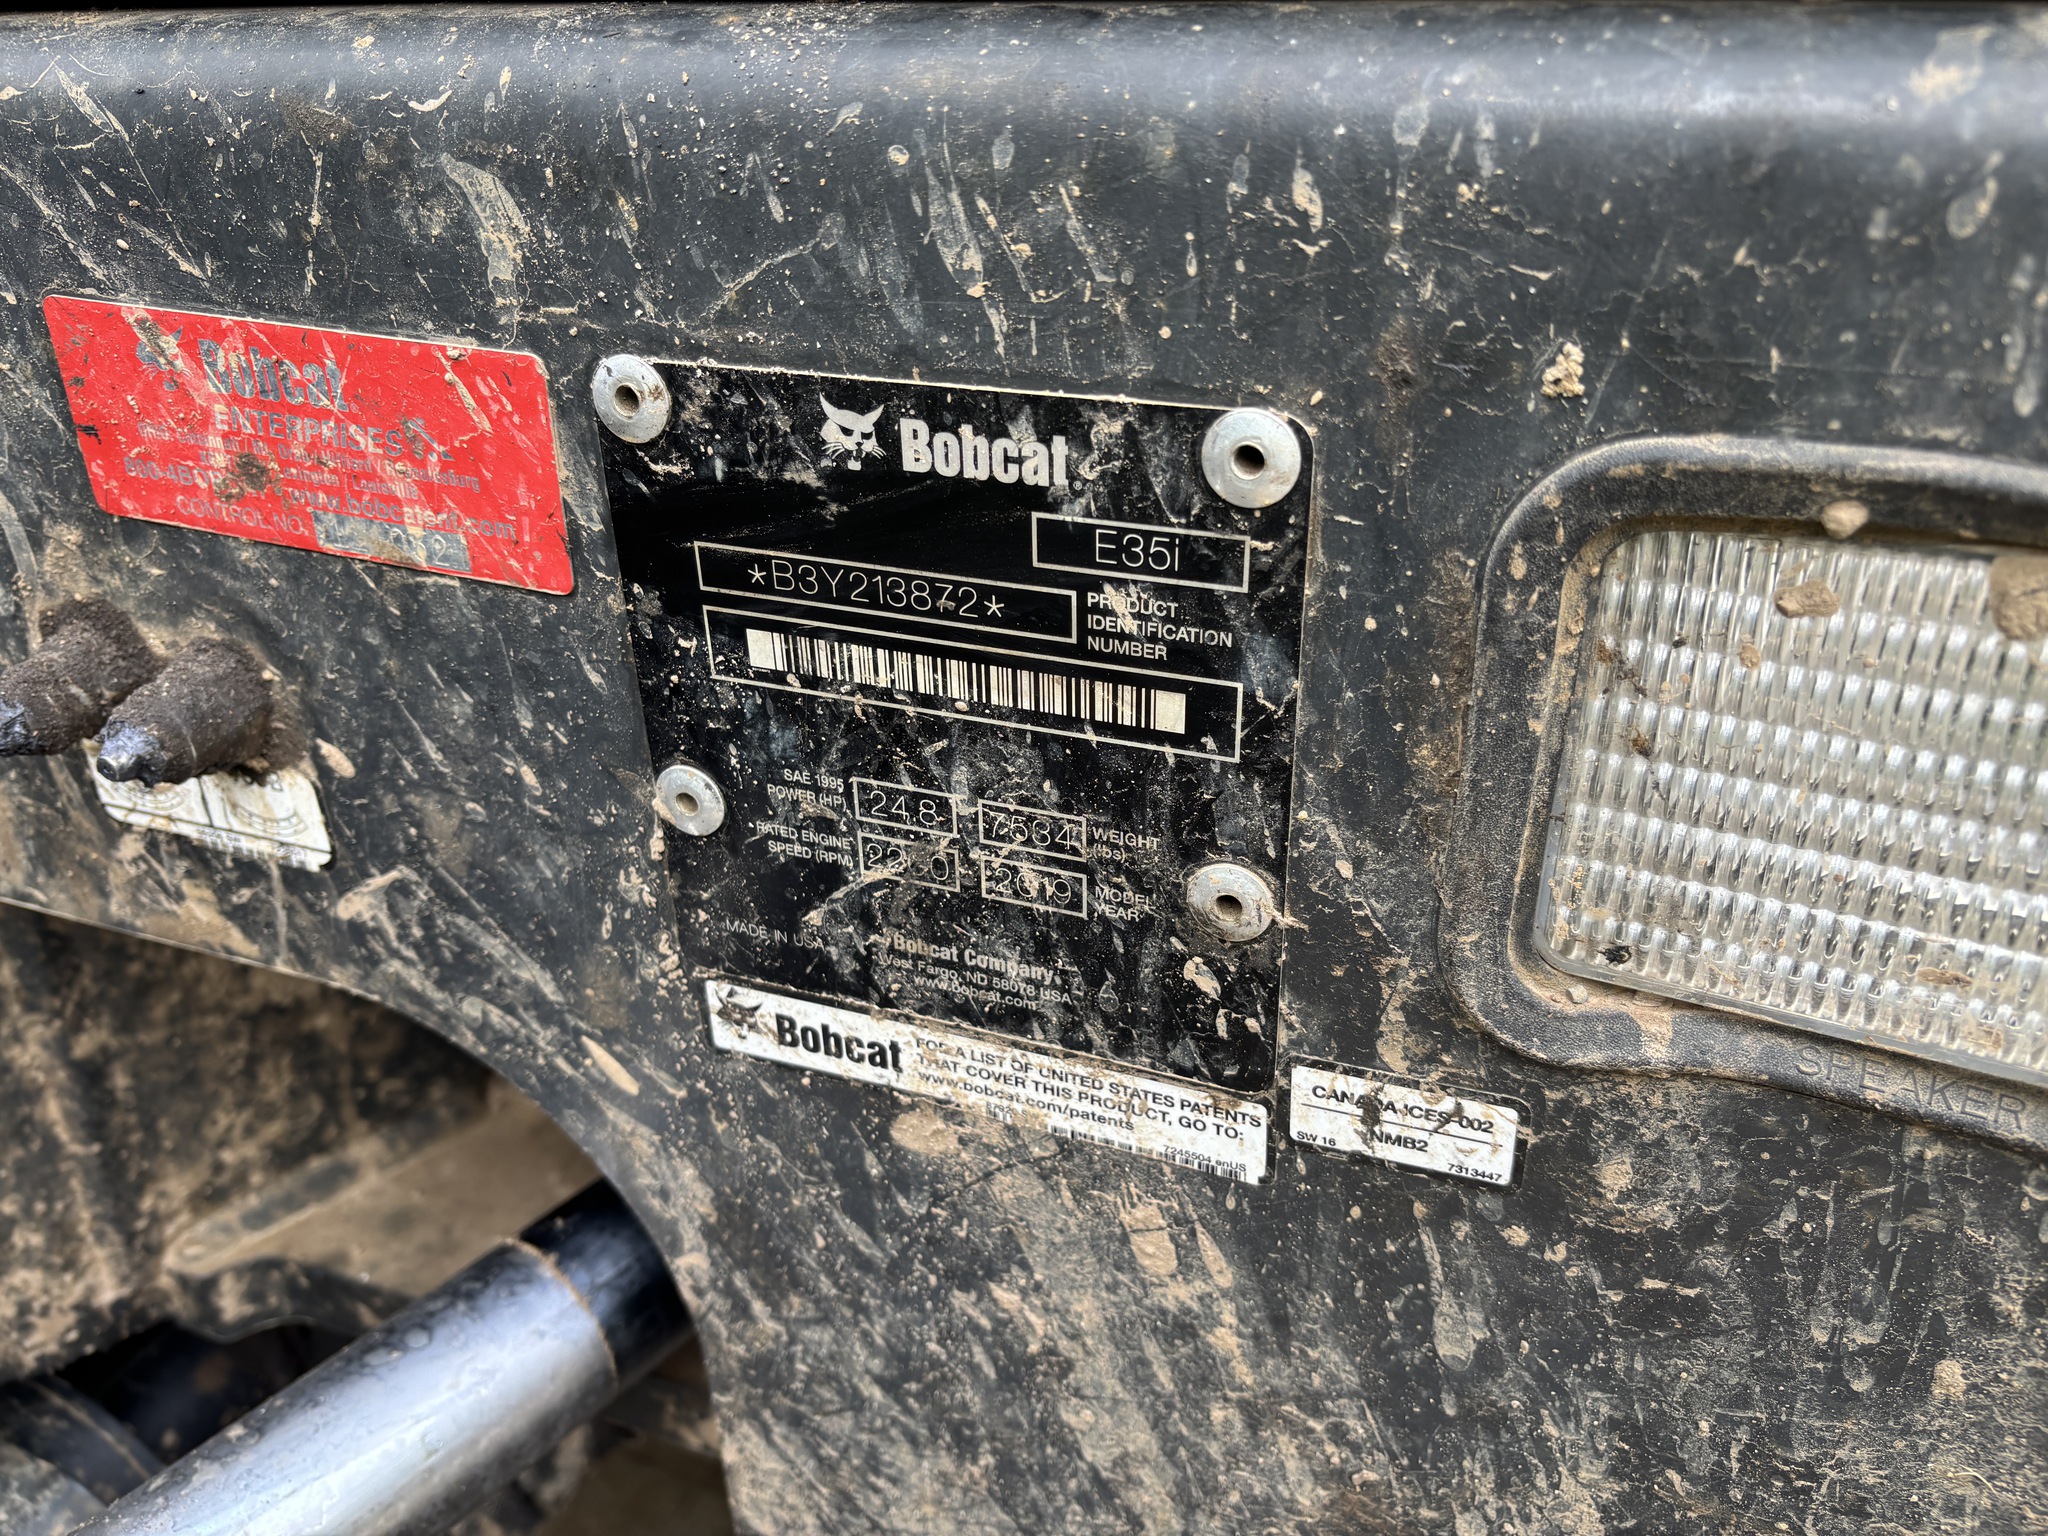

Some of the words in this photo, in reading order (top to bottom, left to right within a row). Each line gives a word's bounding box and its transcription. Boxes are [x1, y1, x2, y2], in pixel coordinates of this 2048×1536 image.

[198, 338, 349, 413] Bobcat
[213, 403, 403, 457] ENTERPRISES
[899, 417, 1069, 488] Bobcat
[280, 465, 340, 488] exington
[352, 474, 419, 500] Louisville
[176, 494, 271, 530] CONTROL
[289, 489, 517, 541] www.bobcatent.com
[1095, 528, 1180, 572] E35i
[1087, 613, 1233, 648] IDENTIFICATION
[1087, 635, 1168, 661] NUMBER
[783, 768, 811, 786] SAE
[814, 775, 845, 791] 1995
[767, 783, 816, 804] POWER
[818, 794, 848, 812] (HP)
[756, 820, 799, 840] RATED
[801, 829, 851, 850] ENGINE
[1092, 826, 1160, 851] WEIGHT
[767, 840, 812, 860] SPEED
[815, 849, 854, 869] (RPM)
[994, 867, 1072, 905] 2019
[1094, 885, 1155, 909] MODEL
[1098, 900, 1140, 923] YEAR
[725, 919, 768, 940] MADE
[774, 929, 788, 944] IN
[793, 933, 825, 952] USA
[893, 934, 959, 963] Bobcat
[877, 952, 914, 970] West
[966, 971, 989, 986] ND
[992, 977, 1036, 998] 58078
[1039, 986, 1073, 1005] USA
[914, 975, 1038, 1011] www.bobcat.com
[775, 1012, 904, 1074] Bobcat
[915, 1052, 965, 1073] TAT
[965, 1063, 1027, 1090] COVER
[1032, 1079, 1073, 1100] THIS
[1078, 1090, 1173, 1126] PRODUCT,
[1178, 1116, 1207, 1132] GO
[1212, 1122, 1245, 1142] TO:
[917, 1071, 1135, 1132] www.bobcat.com/patents
[956, 1046, 967, 1060] A
[971, 1049, 1005, 1068] LIST
[1010, 1058, 1035, 1074] OF
[1039, 1066, 1104, 1091] UNITED
[1108, 1081, 1175, 1108] STATES
[1179, 1098, 1262, 1128] PATENTS
[1794, 1044, 2029, 1131] SPEAKER
[1311, 1085, 1398, 1116] CANAA
[1402, 1103, 1495, 1134] ICES-002
[1296, 1130, 1318, 1142] SW
[1321, 1135, 1337, 1147] 16
[1163, 1144, 1212, 1164] 7245504
[1215, 1159, 1247, 1172] enUS
[1447, 1163, 1503, 1182] 7313447
